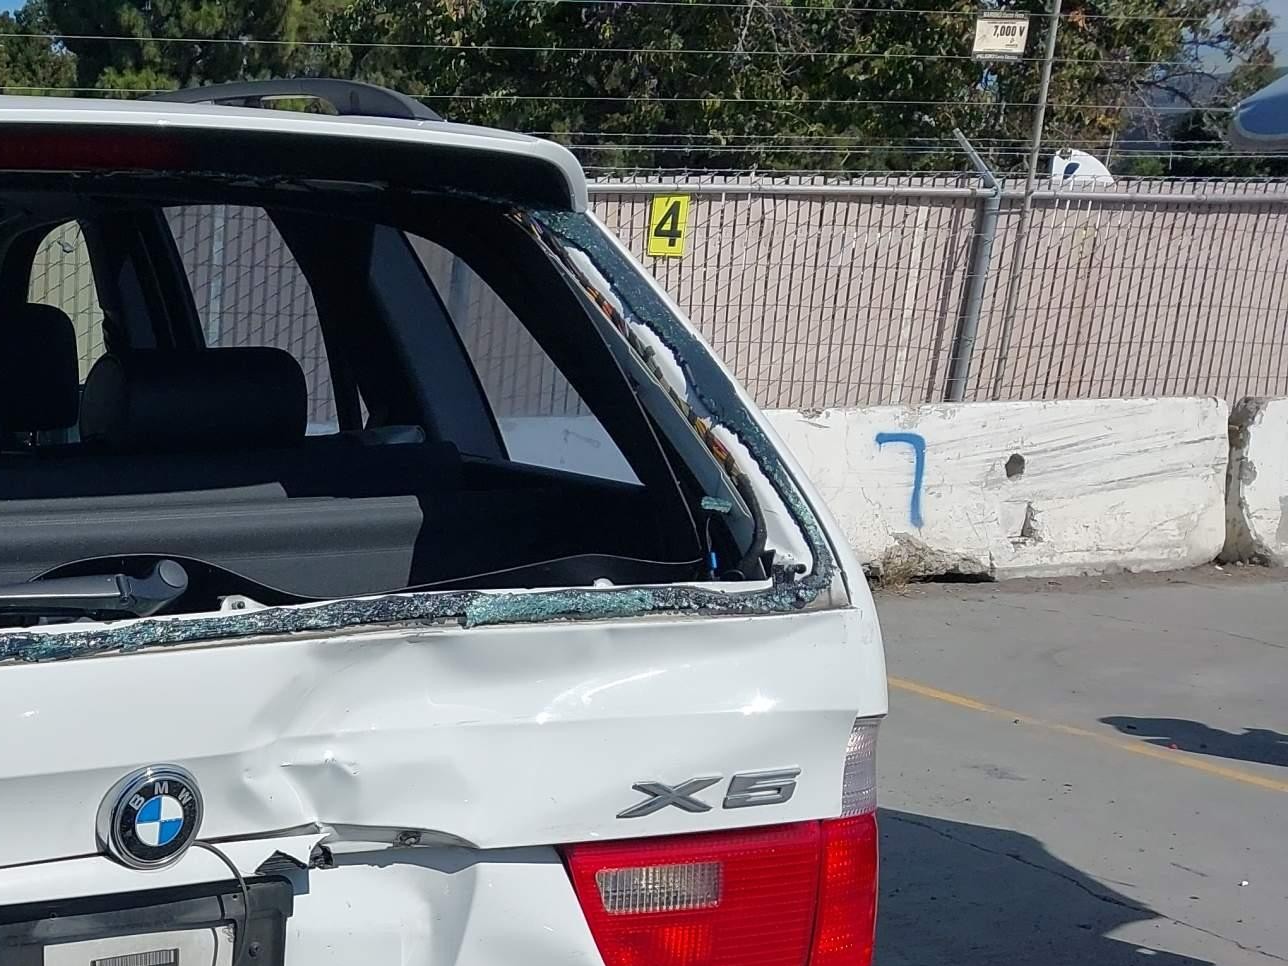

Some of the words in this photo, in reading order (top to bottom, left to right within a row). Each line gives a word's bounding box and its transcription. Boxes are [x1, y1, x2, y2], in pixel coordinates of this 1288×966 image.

[993, 25, 1017, 38] 7,000
[1019, 25, 1026, 37] V
[654, 200, 682, 247] 4
[875, 432, 926, 528] 7
[128, 780, 193, 806] BMW
[615, 766, 802, 820] X5
